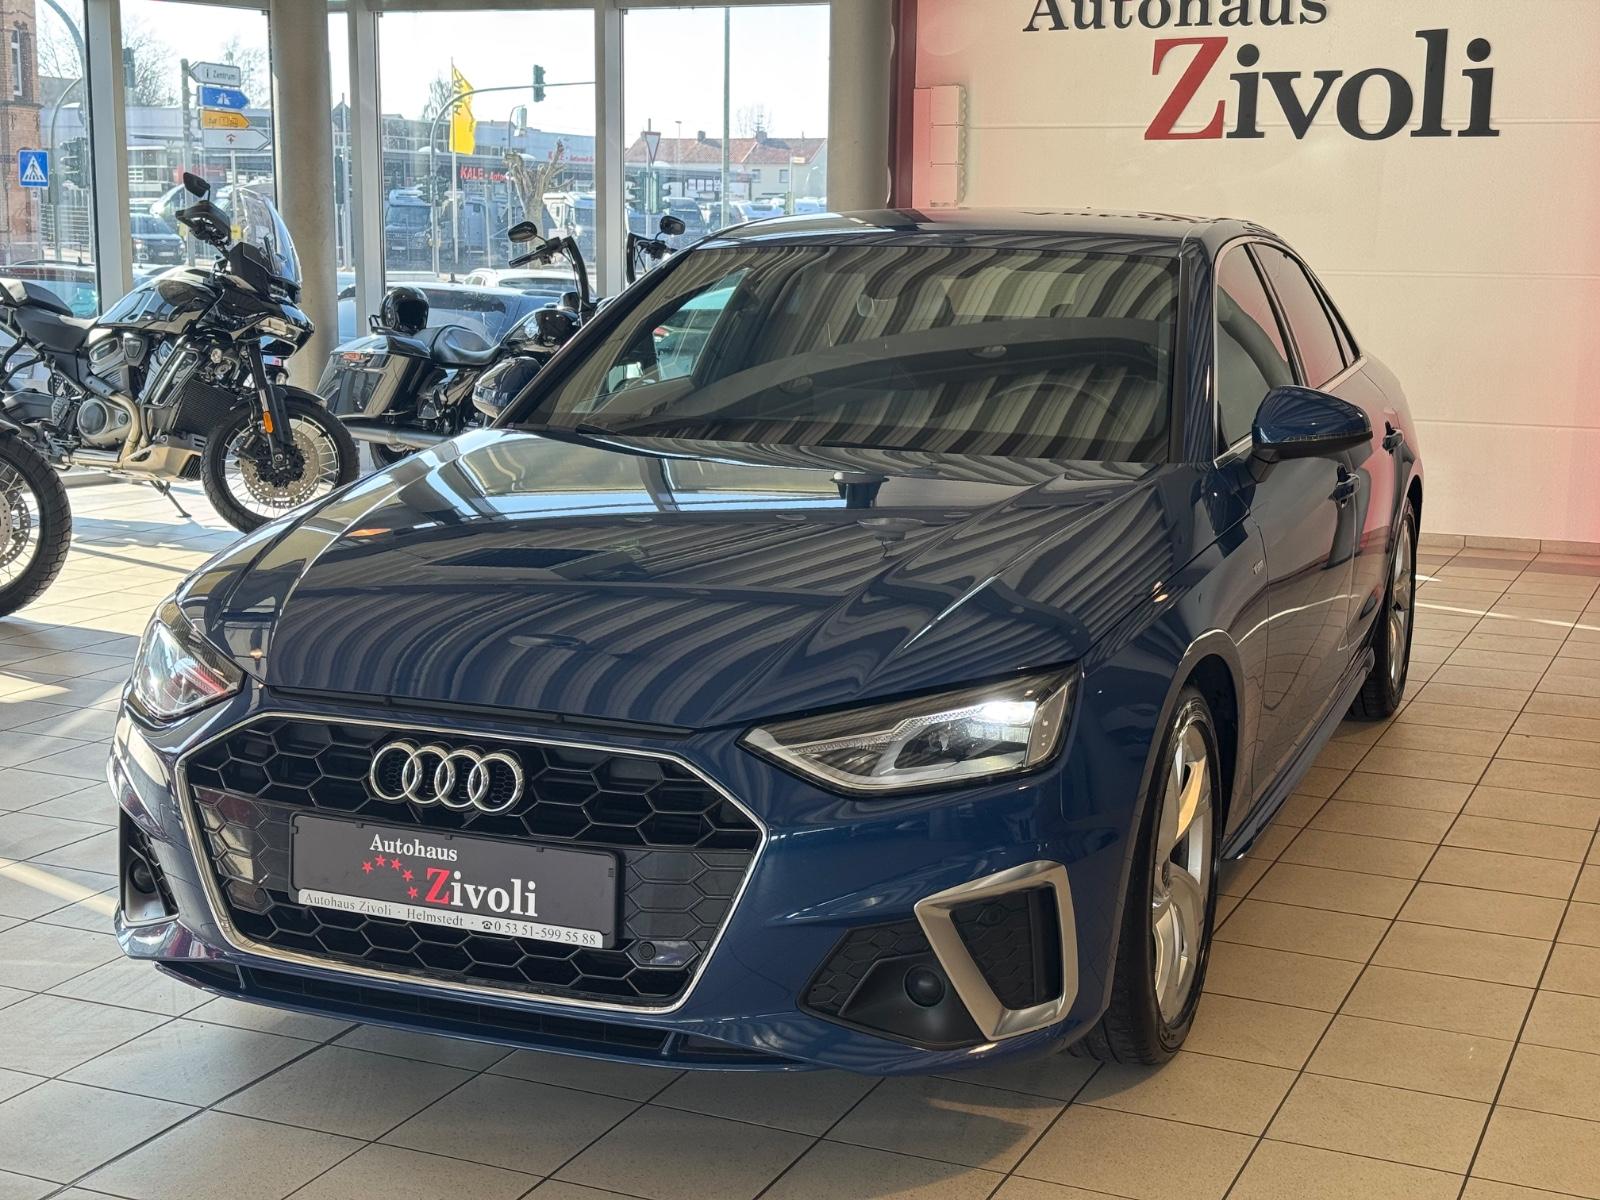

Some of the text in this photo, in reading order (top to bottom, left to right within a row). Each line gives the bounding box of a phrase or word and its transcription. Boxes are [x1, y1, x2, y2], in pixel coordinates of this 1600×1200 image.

[1023, 0, 1328, 32] Autohaus
[213, 69, 236, 80] Zentrum
[1144, 28, 1500, 141] Zivoli
[460, 166, 484, 180] KALE
[369, 833, 458, 862] Autohaus
[425, 866, 538, 917] Zivoli
[305, 893, 355, 910] Autohaus
[359, 901, 392, 916] Zivoli
[407, 908, 464, 926] Helmstedt
[505, 922, 518, 934] 53
[522, 925, 561, 940] 51-599
[565, 931, 578, 943] 55
[582, 933, 596, 945] 88
